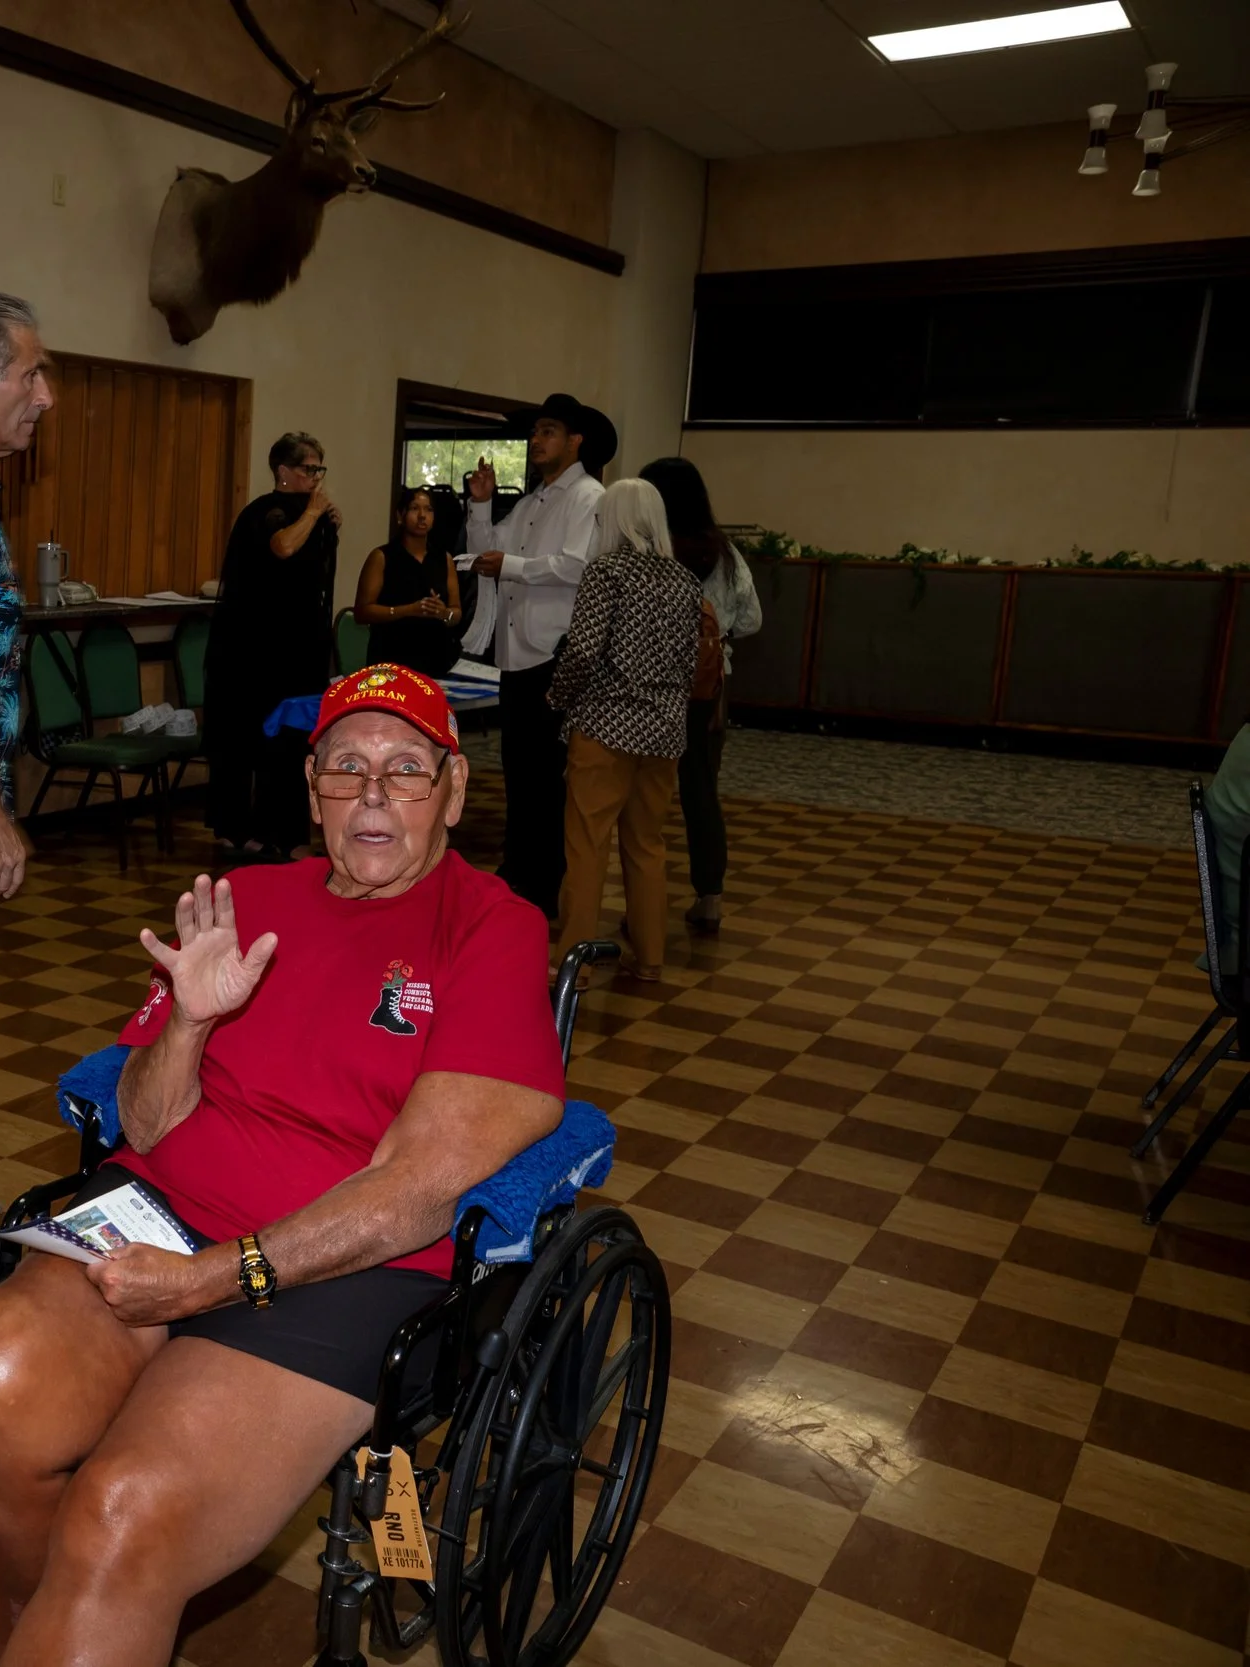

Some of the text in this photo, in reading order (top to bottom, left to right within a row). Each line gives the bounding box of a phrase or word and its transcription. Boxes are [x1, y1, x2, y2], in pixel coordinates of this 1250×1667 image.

[345, 689, 406, 703] VETERAN
[401, 669, 435, 696] CORPS
[384, 1511, 405, 1542] RNO
[411, 1509, 422, 1547] DESTINATION
[382, 1556, 425, 1569] XE 101774
